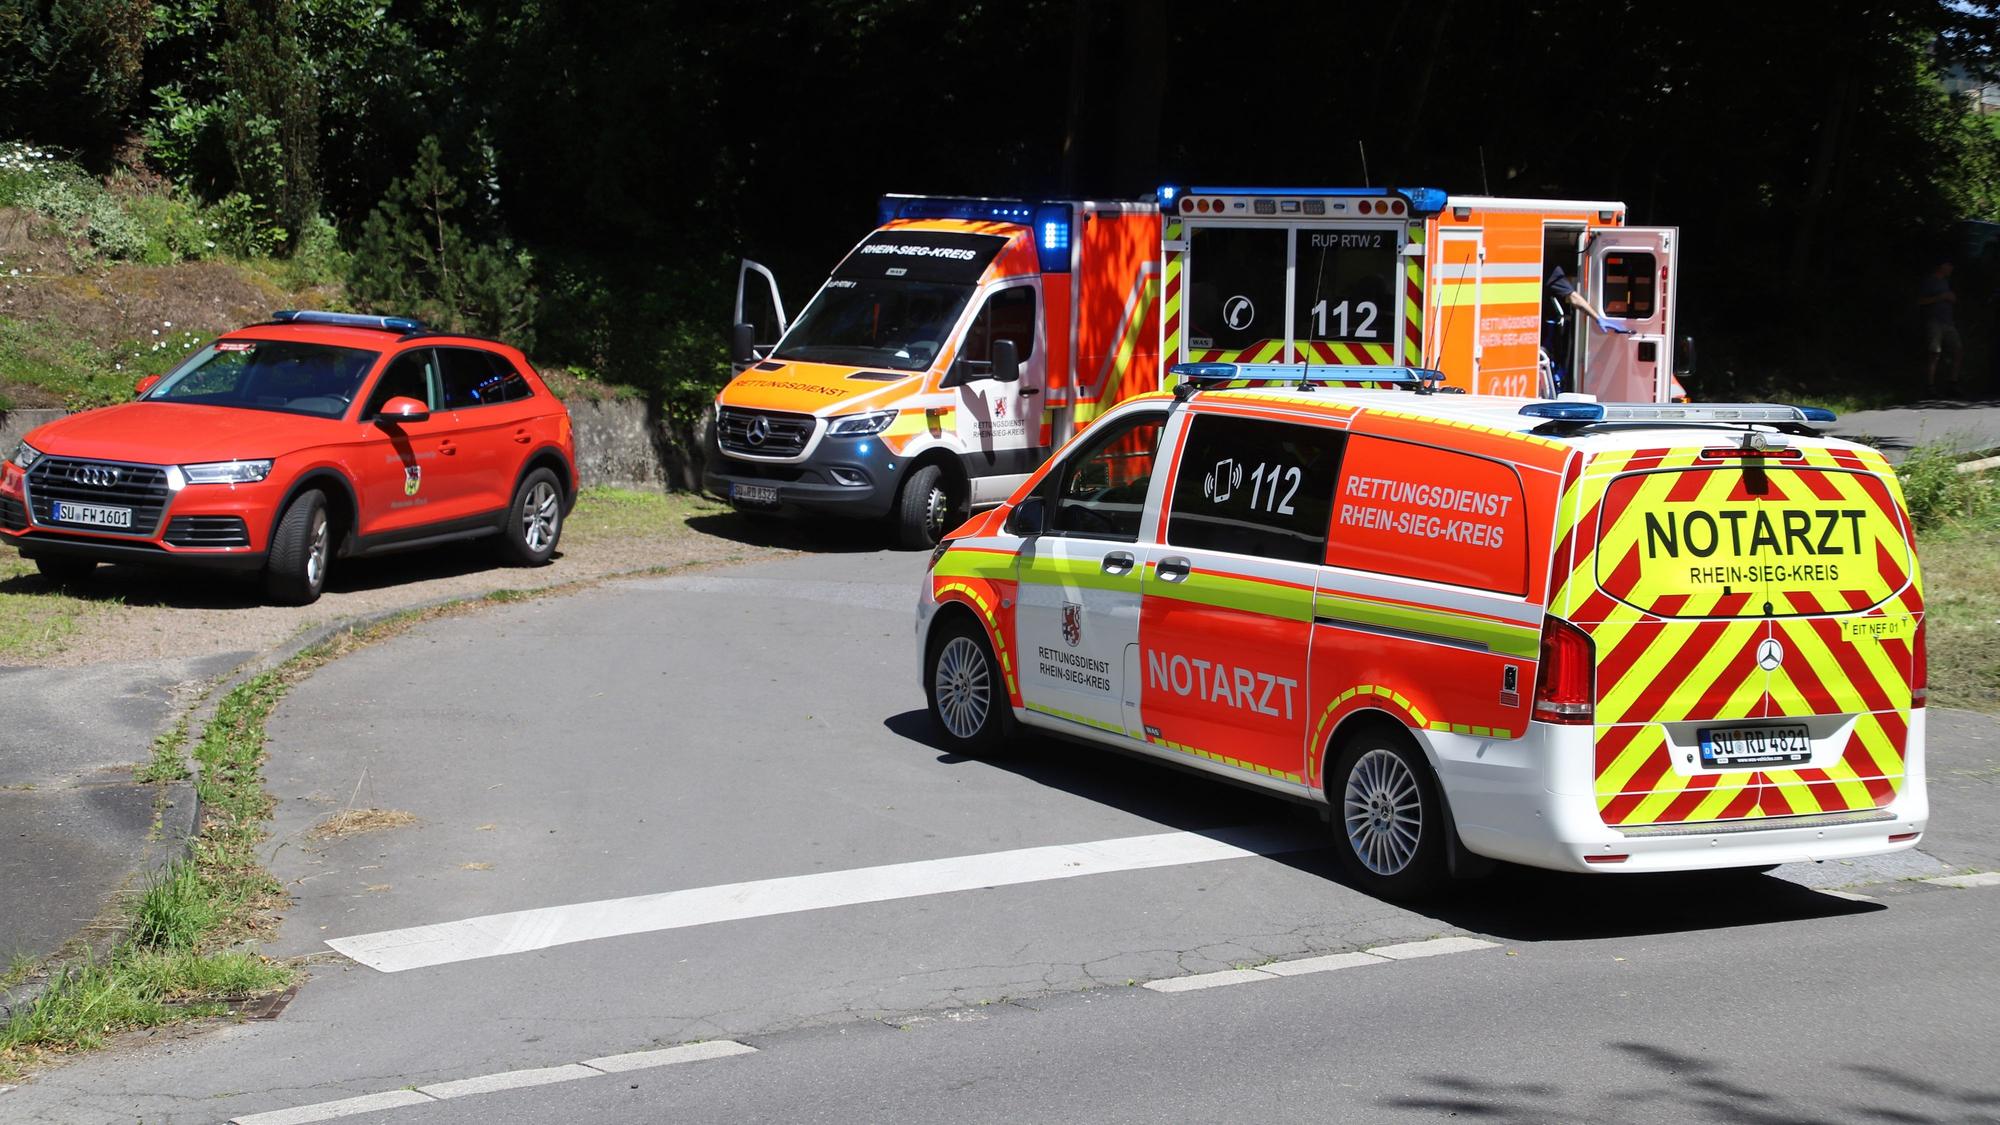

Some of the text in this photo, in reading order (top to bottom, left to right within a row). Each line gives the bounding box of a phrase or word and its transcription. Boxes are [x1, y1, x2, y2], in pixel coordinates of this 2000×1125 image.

[861, 244, 976, 260] RHEIN-SIEG-KREIS
[1311, 234, 1381, 248] RUP RTW 2
[1312, 299, 1378, 338] 112
[733, 380, 850, 397] RETTUNGSDIENST
[1503, 374, 1528, 397] 112
[973, 420, 1025, 429] RETTUNGSDIENST
[973, 429, 1025, 438] RHEIN-SIEG-KREIS
[1250, 462, 1302, 515] 112
[1345, 475, 1513, 518] RETTUNGSDIENST
[61, 506, 127, 525] SU FW 1601
[1339, 504, 1505, 549] RHEIN-SIEG-KREIS
[1645, 510, 1867, 559] NOTARZT
[1690, 565, 1839, 583] RHEIN-SIEG-KREIS
[1853, 623, 1898, 635] EIT NEF 01
[1039, 646, 1110, 674] RETTUNGSDIENST
[1040, 662, 1110, 691] RHEIN-SIEG-KREIS
[1148, 649, 1298, 720] NOTARZT
[1712, 732, 1734, 755] SU
[1745, 731, 1766, 753] RD
[1770, 729, 1807, 752] 4821
